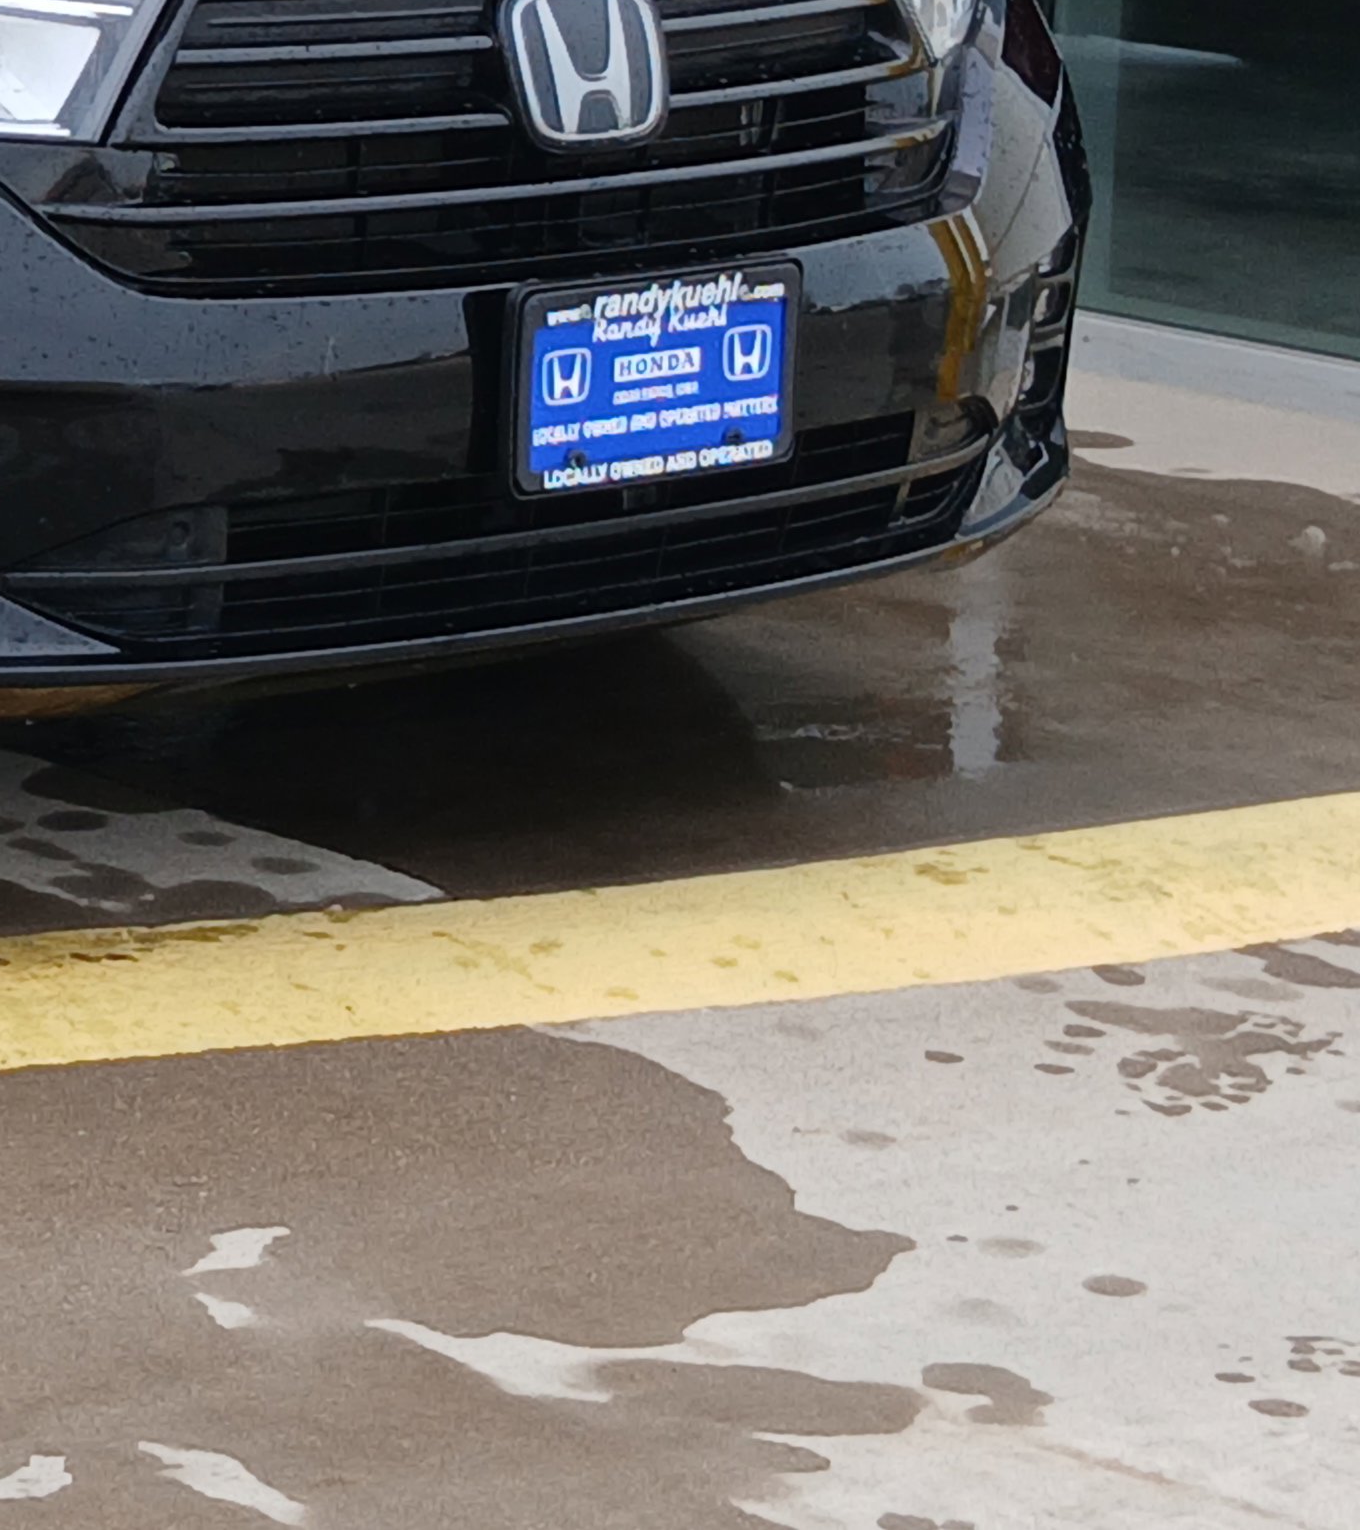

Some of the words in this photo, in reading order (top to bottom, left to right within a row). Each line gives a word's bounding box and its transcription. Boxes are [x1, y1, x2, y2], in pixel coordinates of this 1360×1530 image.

[592, 316, 662, 348] Randy
[667, 303, 728, 333] Kuehl
[618, 351, 696, 377] HONDA
[544, 462, 608, 489] LOCALLY
[610, 456, 664, 481] OWNED
[666, 451, 697, 473] AND
[699, 439, 774, 467] OPERATED
